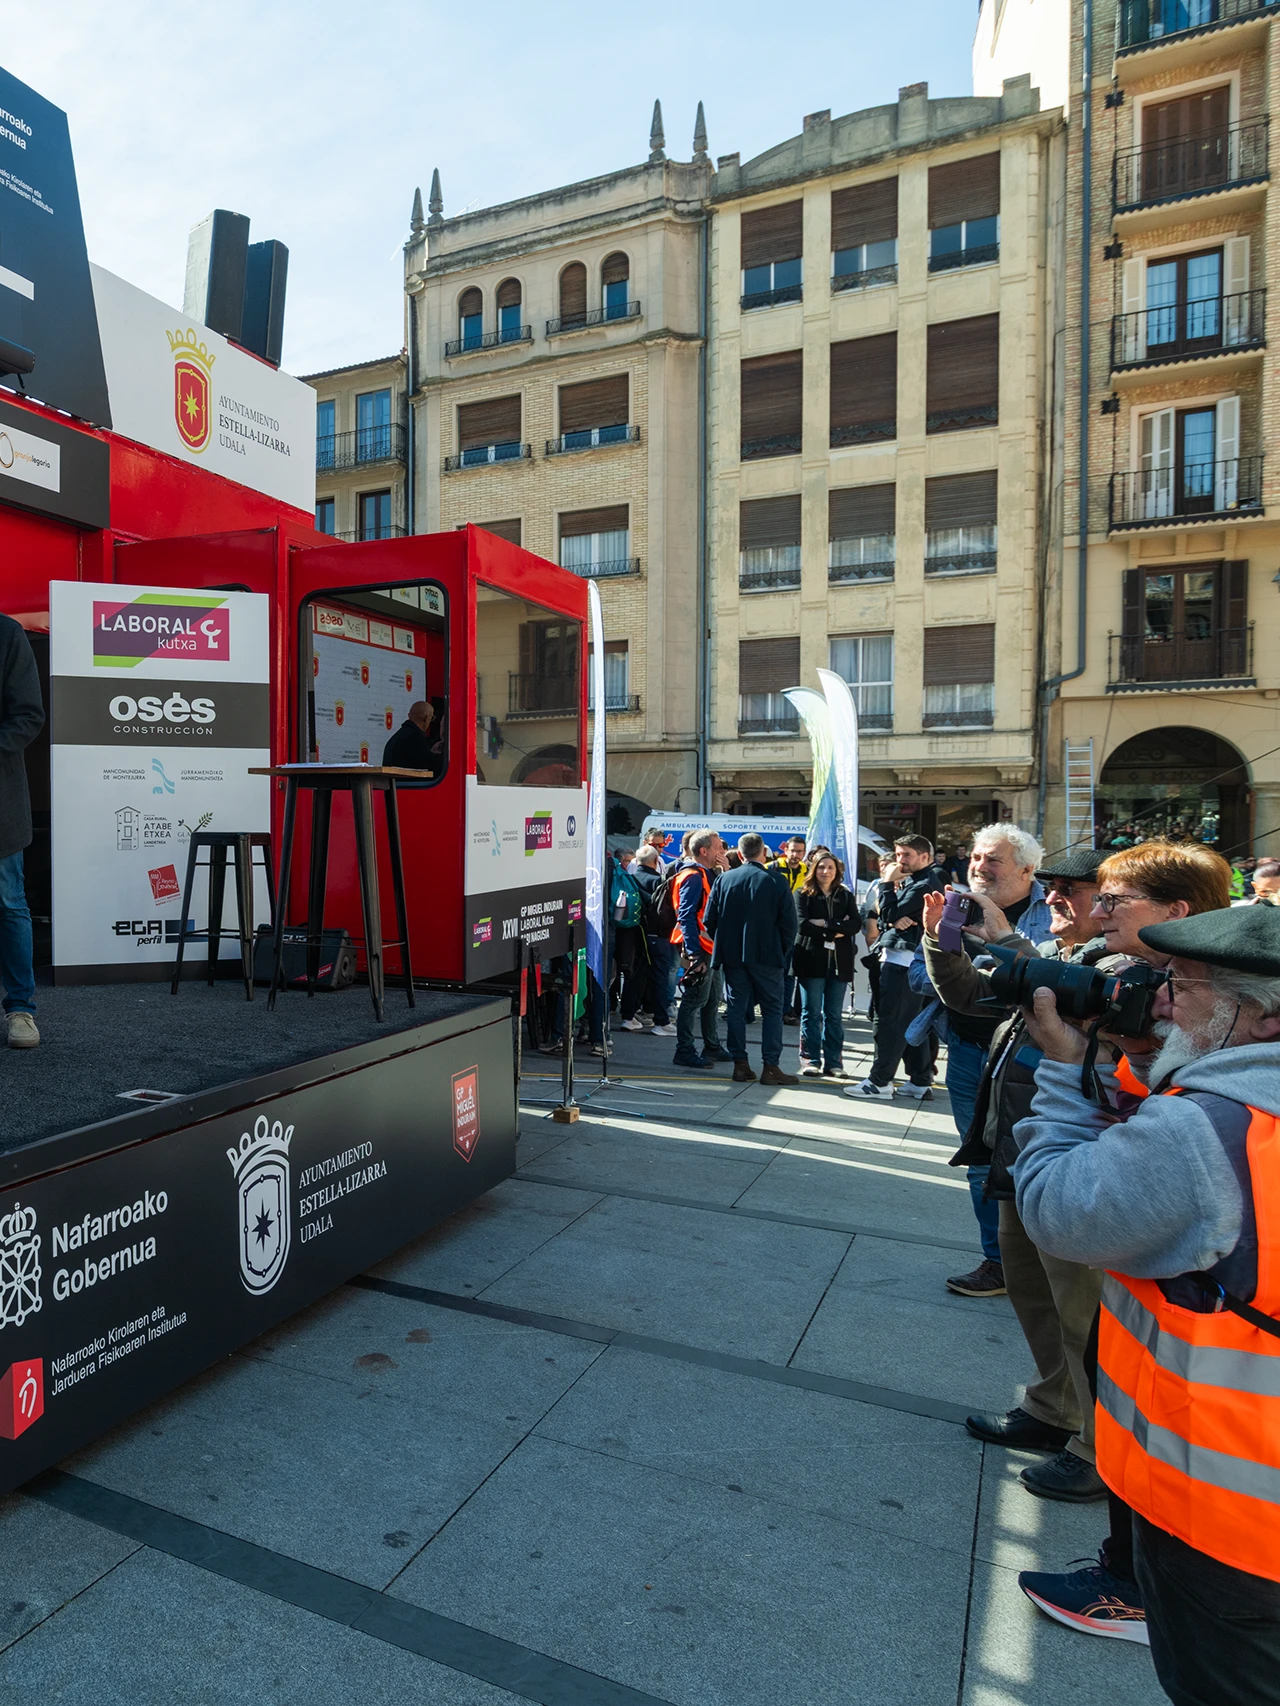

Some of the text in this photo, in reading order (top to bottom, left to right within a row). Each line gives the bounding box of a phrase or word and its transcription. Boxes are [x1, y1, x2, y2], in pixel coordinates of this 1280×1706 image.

[33, 186, 42, 199] eta
[218, 395, 280, 432] AYUNTAMIENTO
[219, 414, 291, 457] ESTELLA-LIZARRA
[219, 434, 246, 456] UDALA
[101, 614, 197, 635] LABORAL
[157, 637, 197, 650] kutxa
[113, 725, 213, 735] CONSTRUCCIÓN
[144, 822, 172, 830] ATABE
[526, 824, 546, 836] LABORAL
[520, 906, 527, 917] GP
[527, 903, 544, 916] MIGUEL
[520, 917, 541, 931] LABORAL
[137, 935, 163, 947] perfil
[456, 1087, 464, 1101] GP
[456, 1098, 475, 1116] MIGUEL
[299, 1141, 373, 1190] AYUNTAMIENTO
[300, 1160, 387, 1218] ESTELLA-LIZARRA
[51, 1189, 168, 1258] Nafarroako
[300, 1213, 334, 1244] UDALA
[52, 1236, 157, 1302] Gobernua
[51, 1304, 166, 1377] Nafarroako Kirolaren eta
[51, 1310, 188, 1398] Jarduera Fisikoaren Institutua
